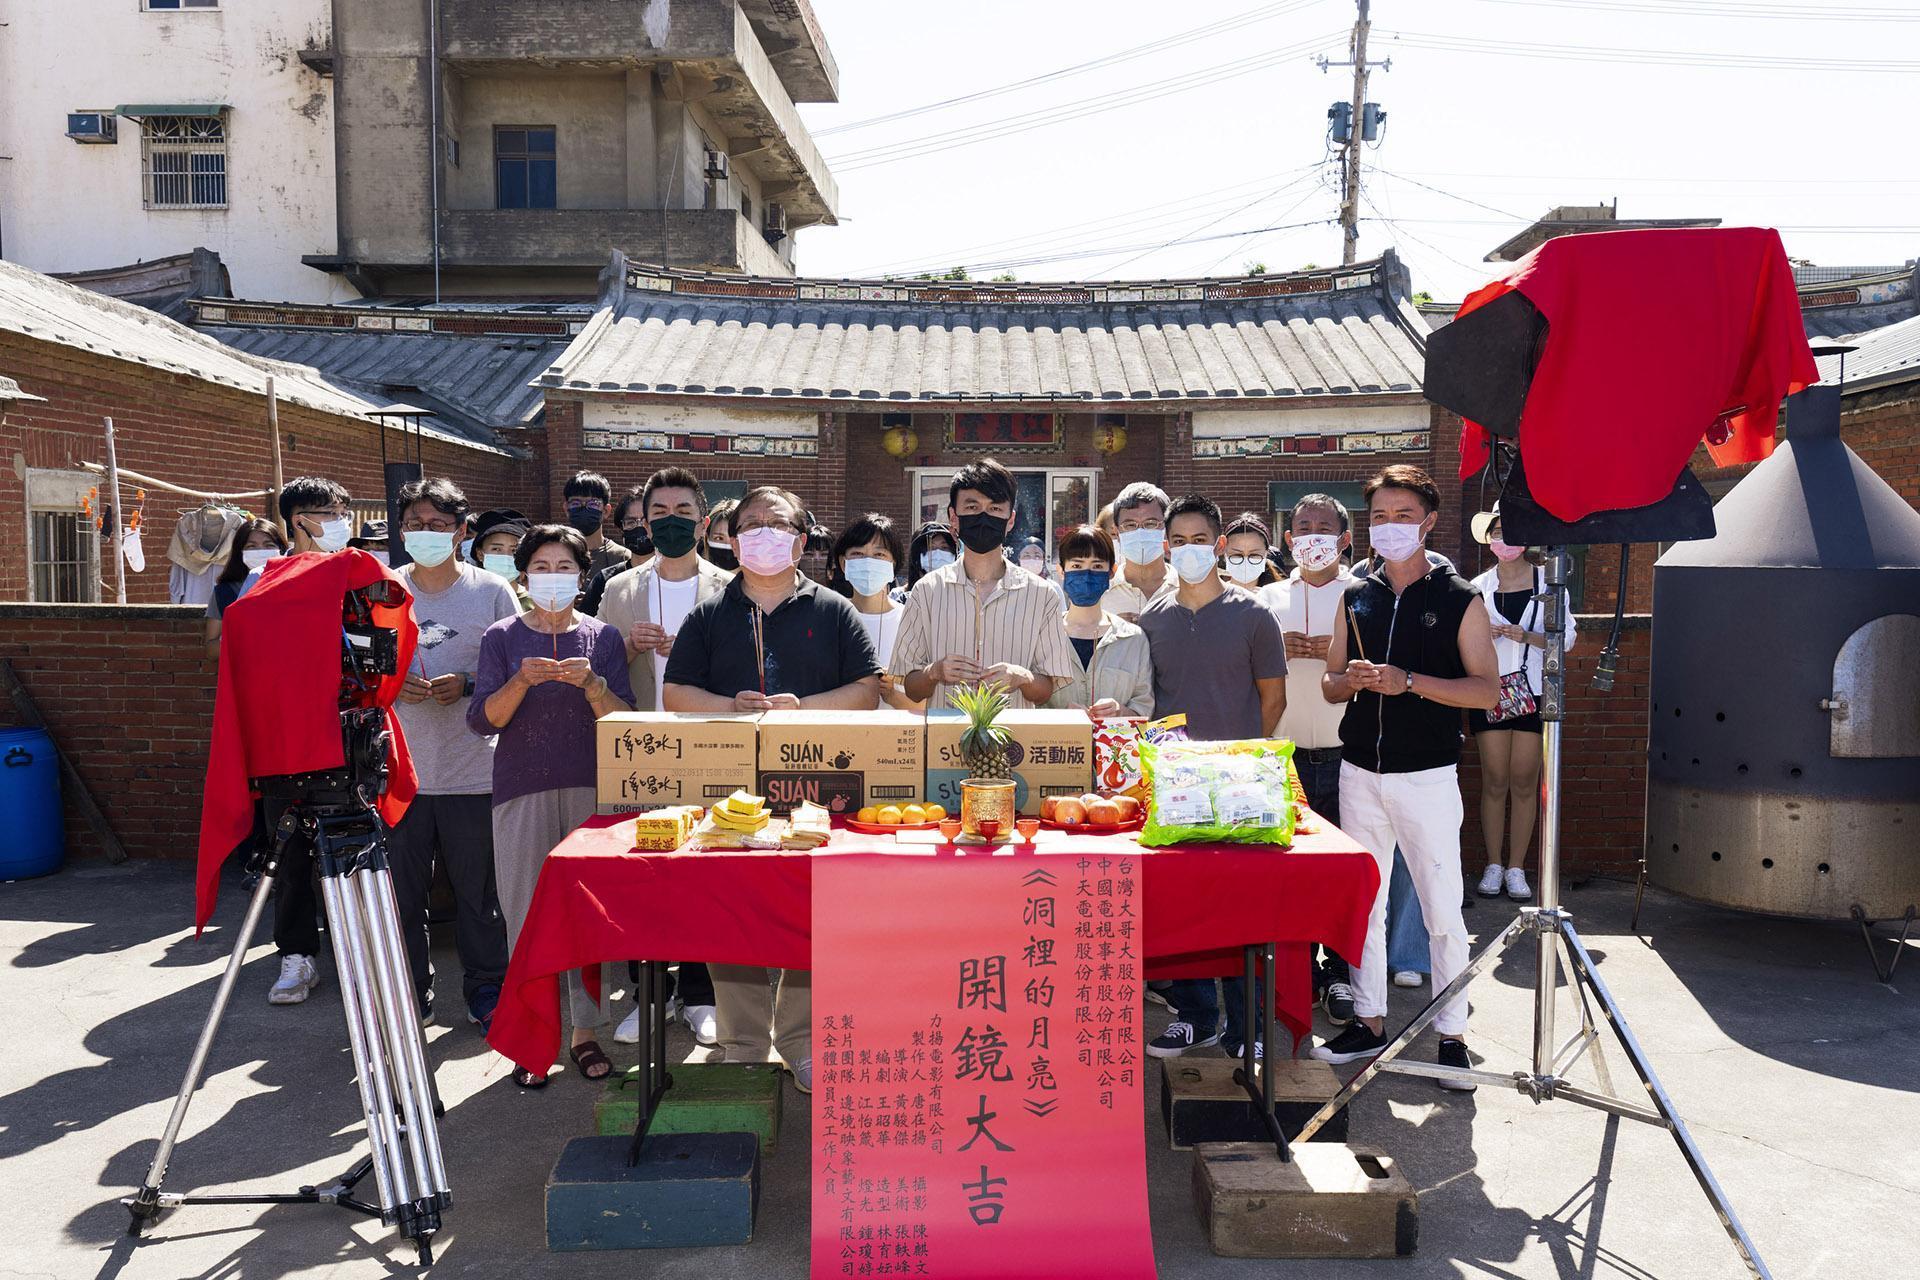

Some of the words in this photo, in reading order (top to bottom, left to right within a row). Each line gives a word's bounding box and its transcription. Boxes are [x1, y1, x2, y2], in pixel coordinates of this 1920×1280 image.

[780, 740, 824, 763] SUÁN
[1029, 746, 1085, 765] 活動版
[768, 776, 820, 803] SUÁN
[1074, 857, 1094, 1067] 中天電視股份有限公司
[1096, 857, 1116, 1109] 中國電視事業股份有限公司
[1117, 857, 1136, 1088] 台灣大哥大股份有限公司
[1022, 868, 1058, 1118] 《洞裡的月亮》
[840, 1014, 856, 1084] 製片團隊
[859, 1049, 873, 1083] 製片
[875, 1049, 891, 1083] 編劇
[893, 1048, 909, 1083] 導演
[911, 1030, 927, 1081] 製作人
[822, 1015, 838, 1195] 及全體演員及工作人員
[928, 1013, 945, 1154] 力揚電影有限公司
[951, 955, 1016, 1226] 開鏡大吉
[875, 1096, 891, 1148] 王昭華
[911, 1093, 927, 1146] 唐在揚
[858, 1178, 874, 1212] 燈光
[876, 1177, 891, 1212] 造型
[895, 1177, 909, 1212] 美術
[912, 1176, 927, 1211] 攝影
